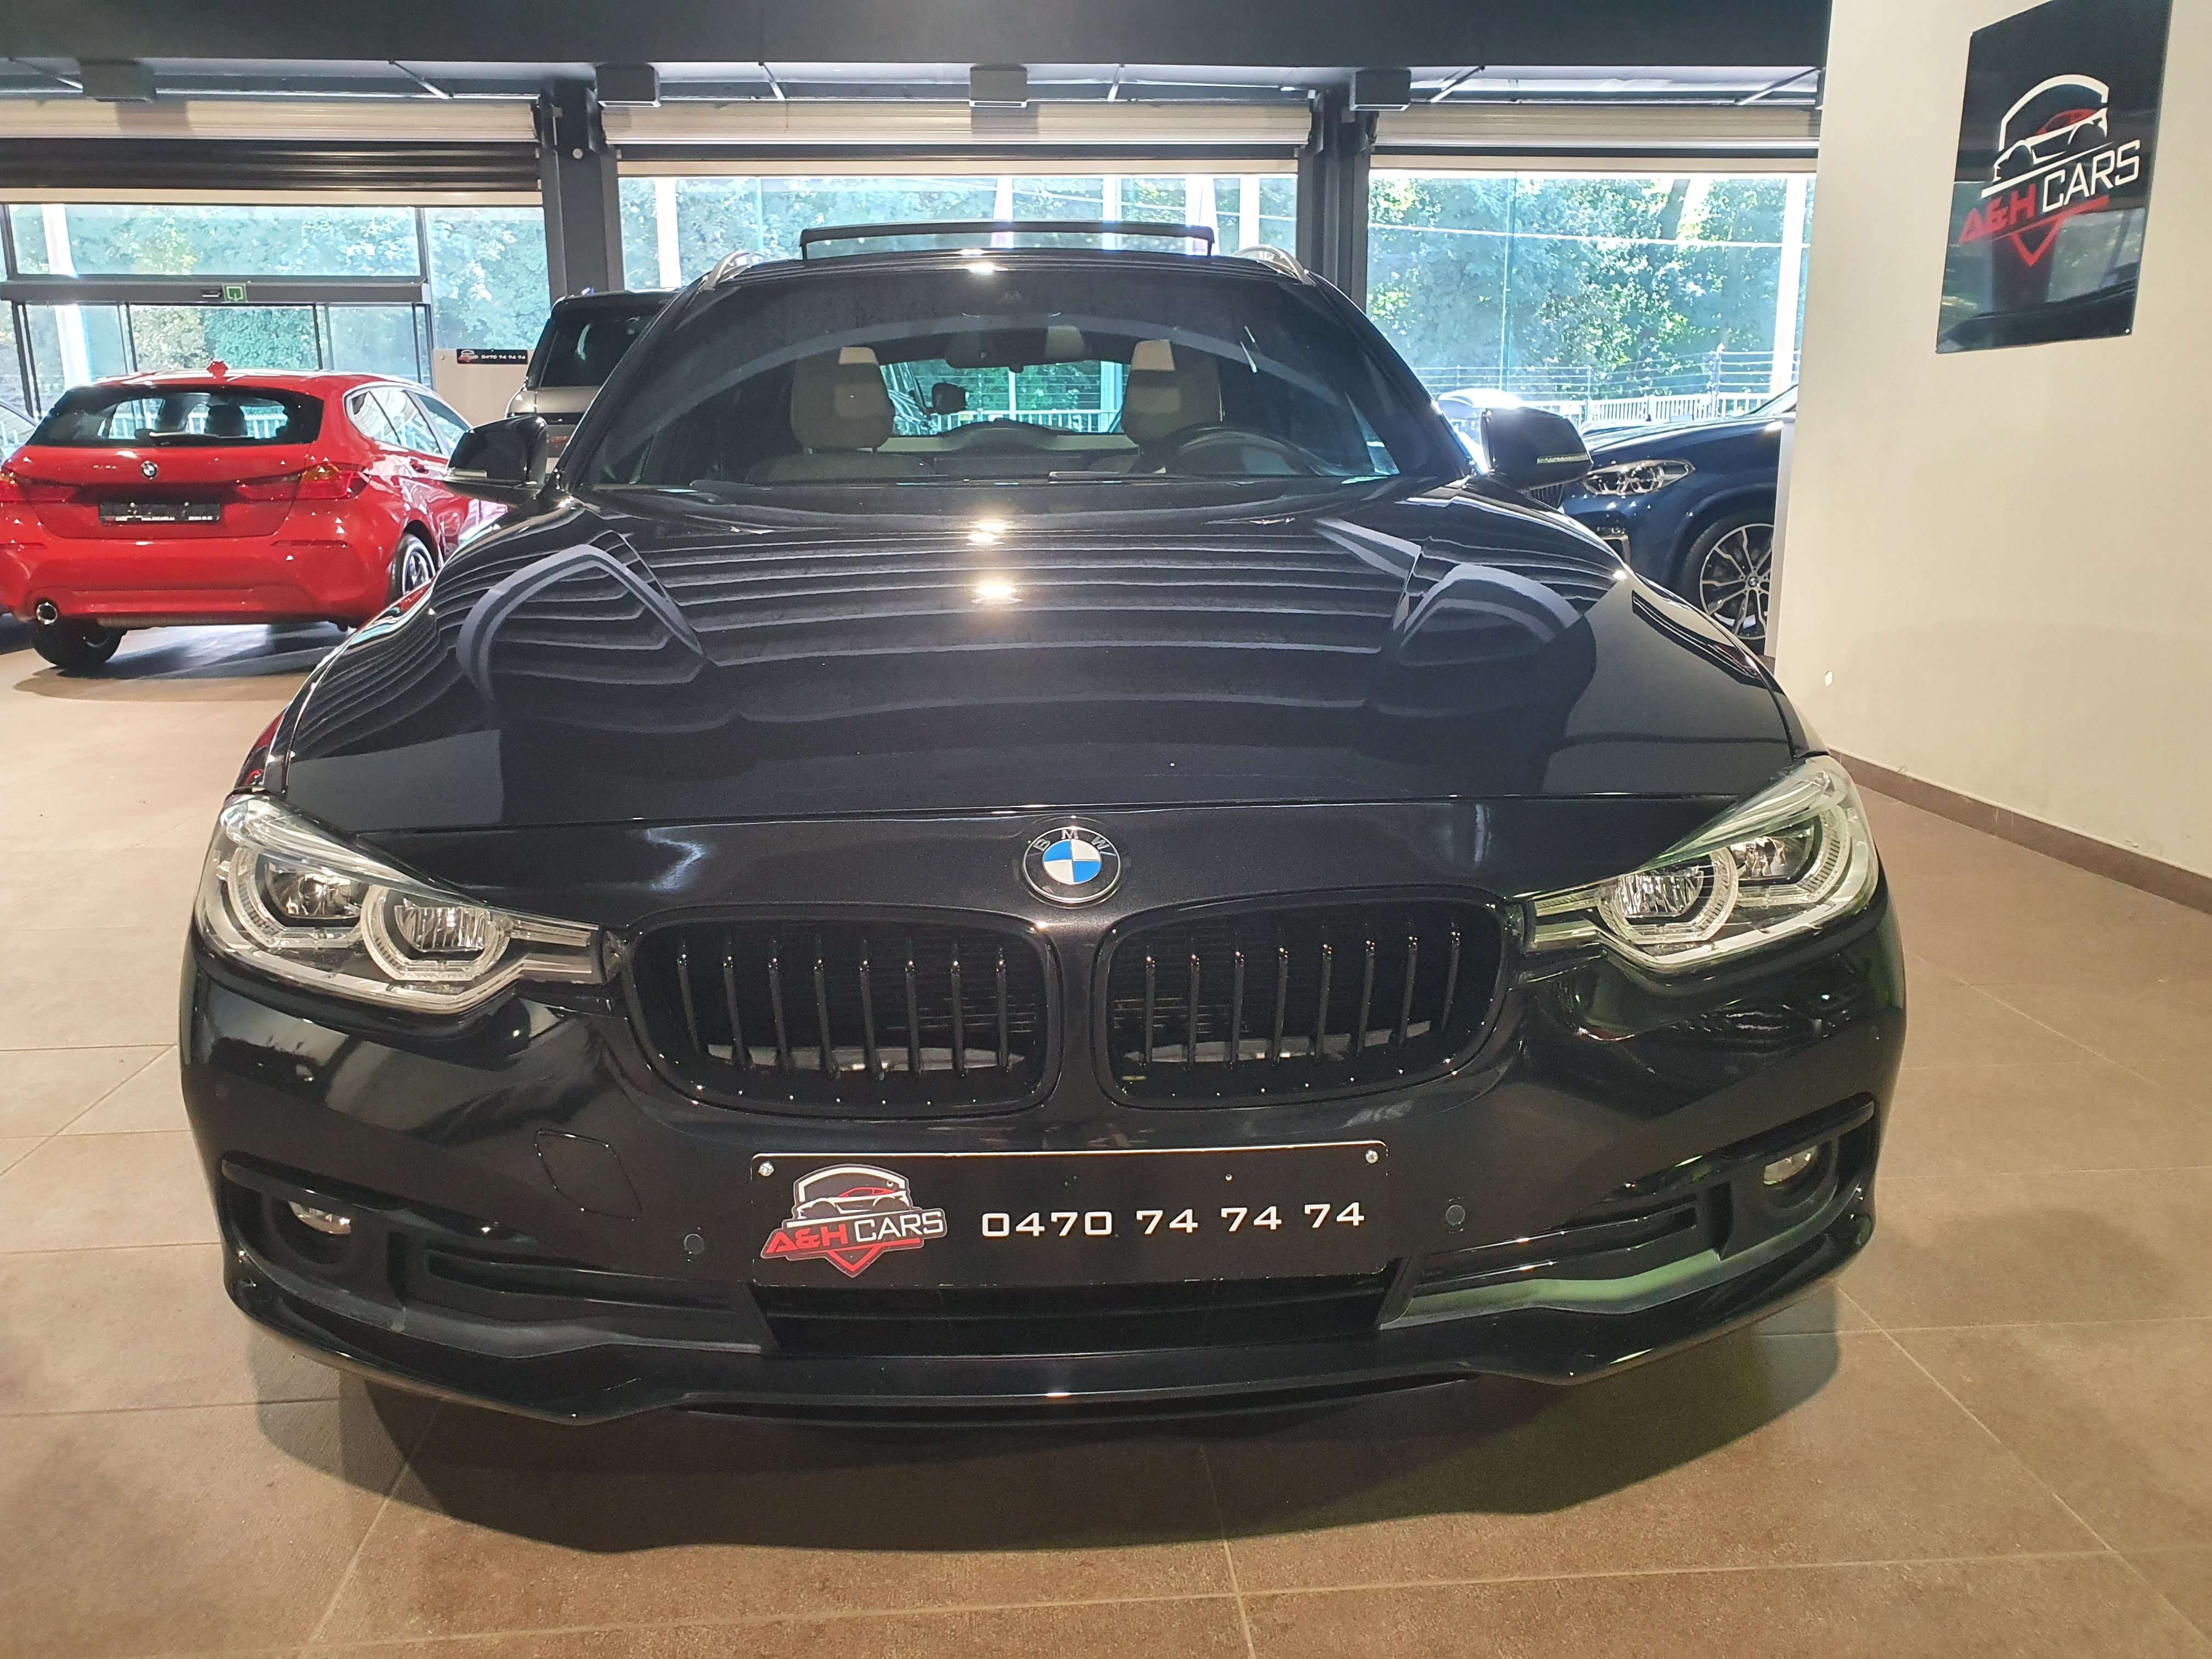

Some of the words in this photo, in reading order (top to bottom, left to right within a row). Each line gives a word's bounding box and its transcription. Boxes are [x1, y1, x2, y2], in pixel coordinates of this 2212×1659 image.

[1959, 184, 2036, 244] A&H
[2042, 139, 2141, 213] CARS
[1032, 829, 1110, 851] BMW
[766, 1223, 848, 1254] A&H
[854, 1211, 943, 1242] CARS
[982, 1211, 1112, 1237] 0470
[1136, 1210, 1198, 1235] 74
[1221, 1206, 1282, 1232] 74
[1304, 1202, 1365, 1228] 74
